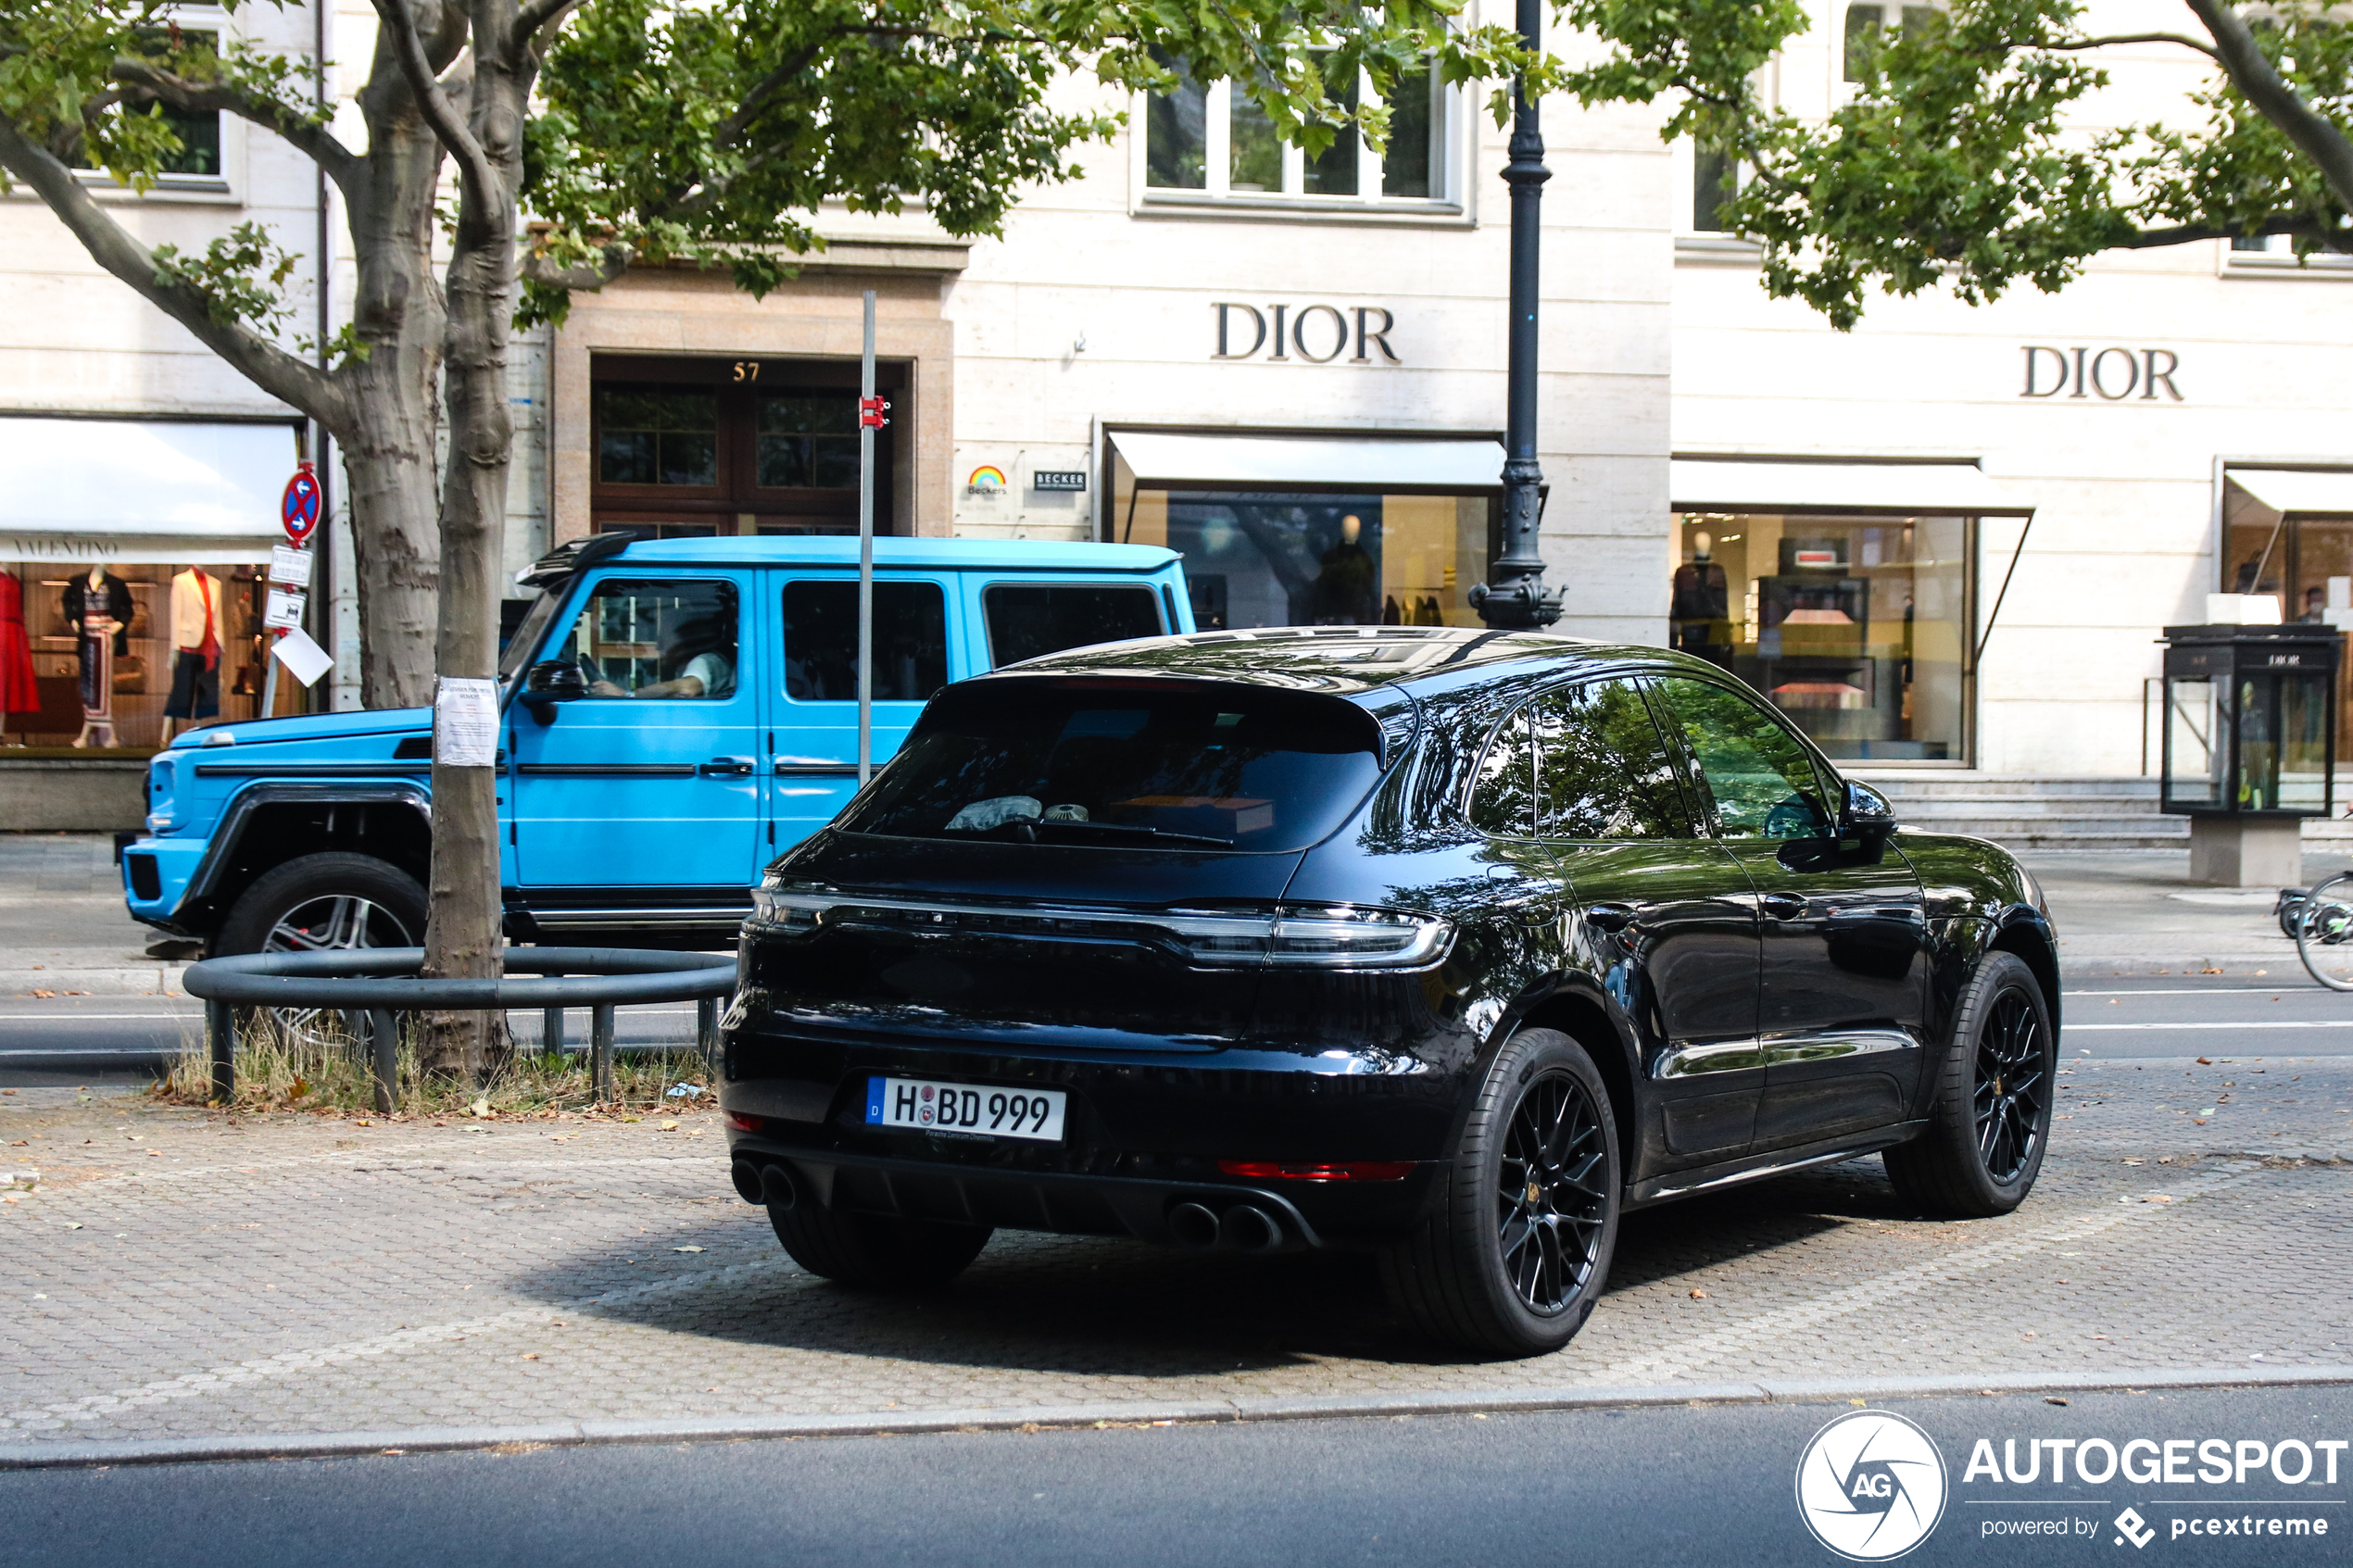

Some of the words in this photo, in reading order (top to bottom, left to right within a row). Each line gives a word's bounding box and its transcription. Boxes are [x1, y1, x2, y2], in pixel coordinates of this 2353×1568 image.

[1210, 302, 1402, 364] DIOR
[733, 361, 760, 382] 57
[2019, 345, 2184, 401] DIOR
[1037, 473, 1084, 483] BECKER
[967, 485, 1007, 495] Beckers
[14, 538, 119, 556] VALENTINO
[2268, 654, 2301, 666] DIOR
[871, 1106, 879, 1116] D
[895, 1085, 917, 1122] H
[937, 1088, 980, 1127] BD
[988, 1093, 1050, 1133] 999
